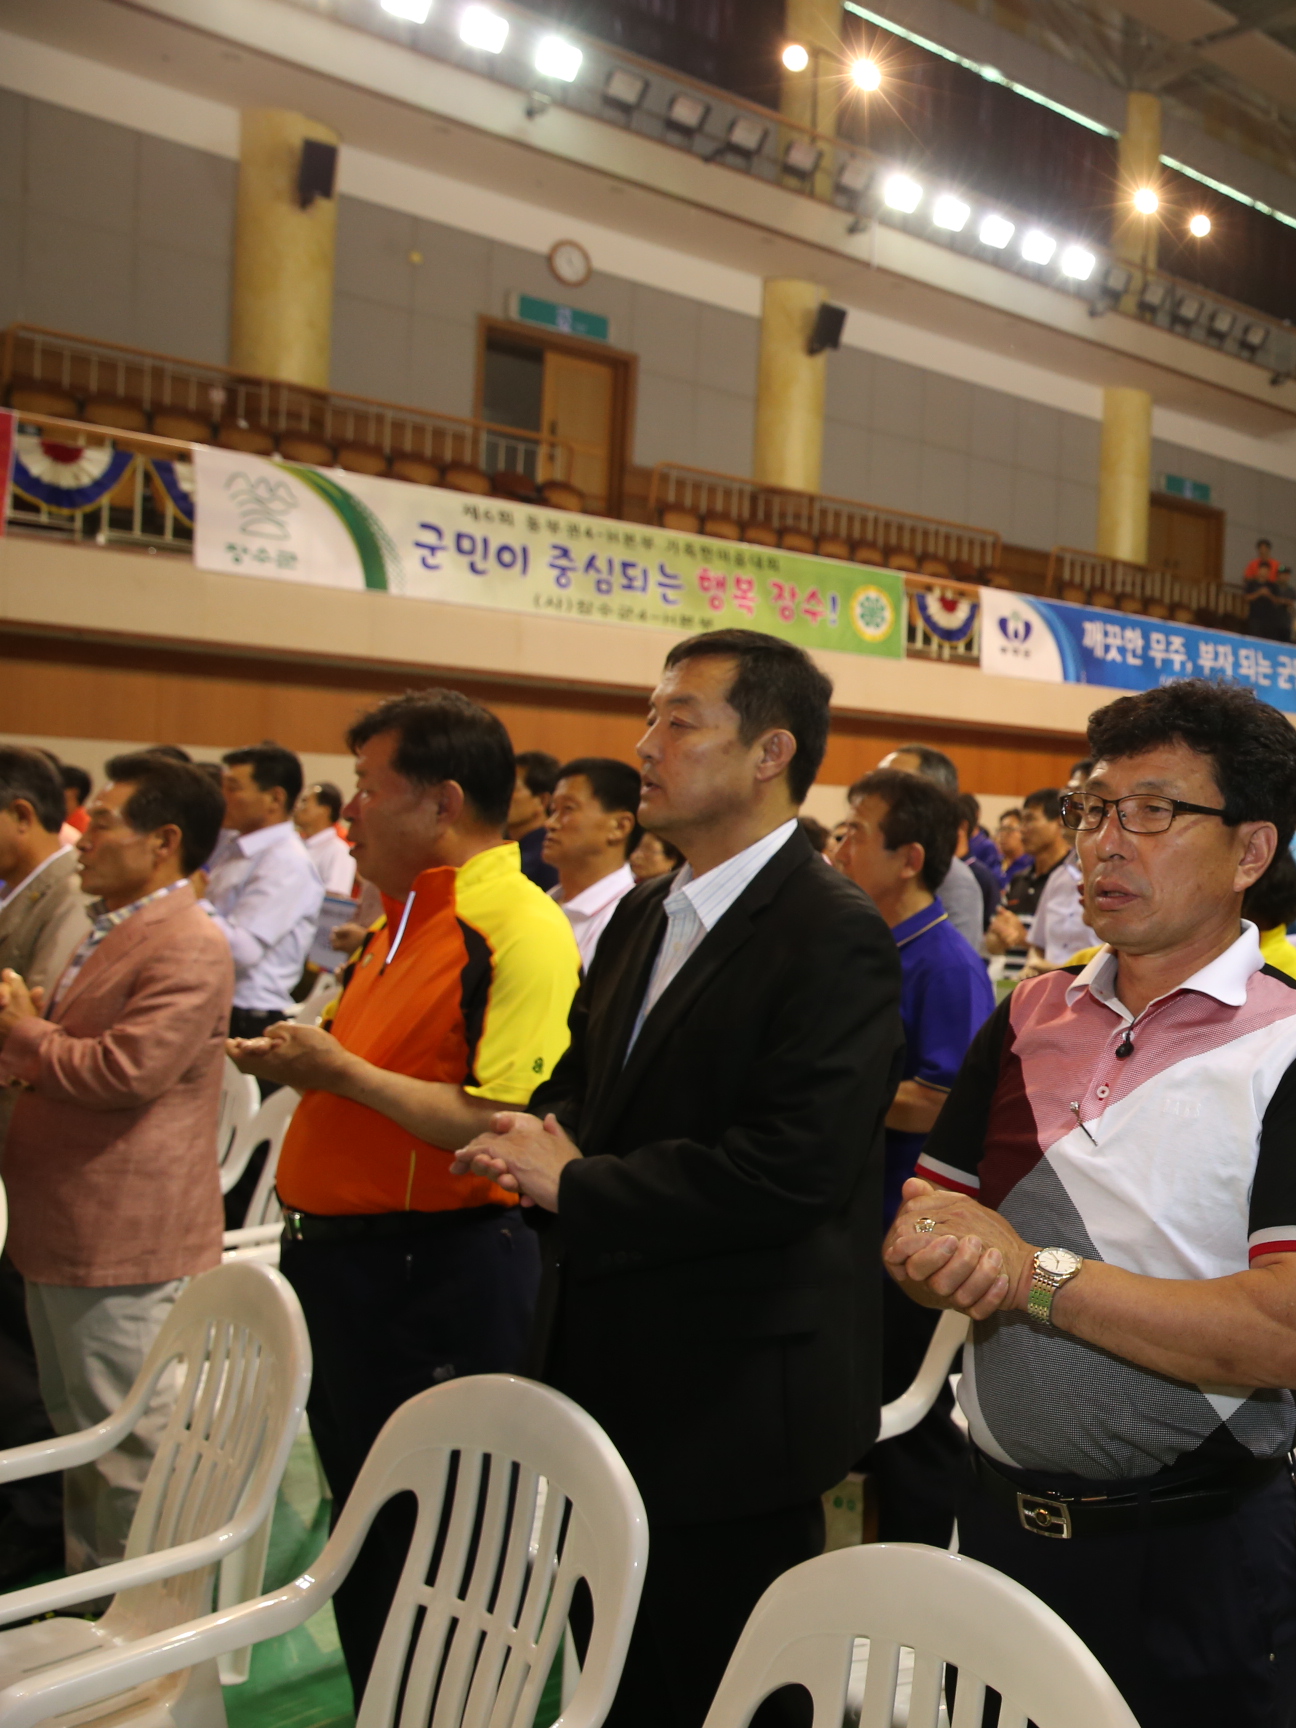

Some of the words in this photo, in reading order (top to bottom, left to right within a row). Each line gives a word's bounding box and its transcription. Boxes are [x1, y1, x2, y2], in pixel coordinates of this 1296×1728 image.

[414, 521, 530, 576] 군민이
[548, 543, 684, 606] 중심되는
[696, 566, 758, 616] 행복
[769, 580, 840, 626] 장수!
[1082, 620, 1145, 666] 깨끗한
[1148, 631, 1194, 675] 무주,
[1197, 640, 1236, 679] 부자
[1238, 647, 1274, 687] 되는
